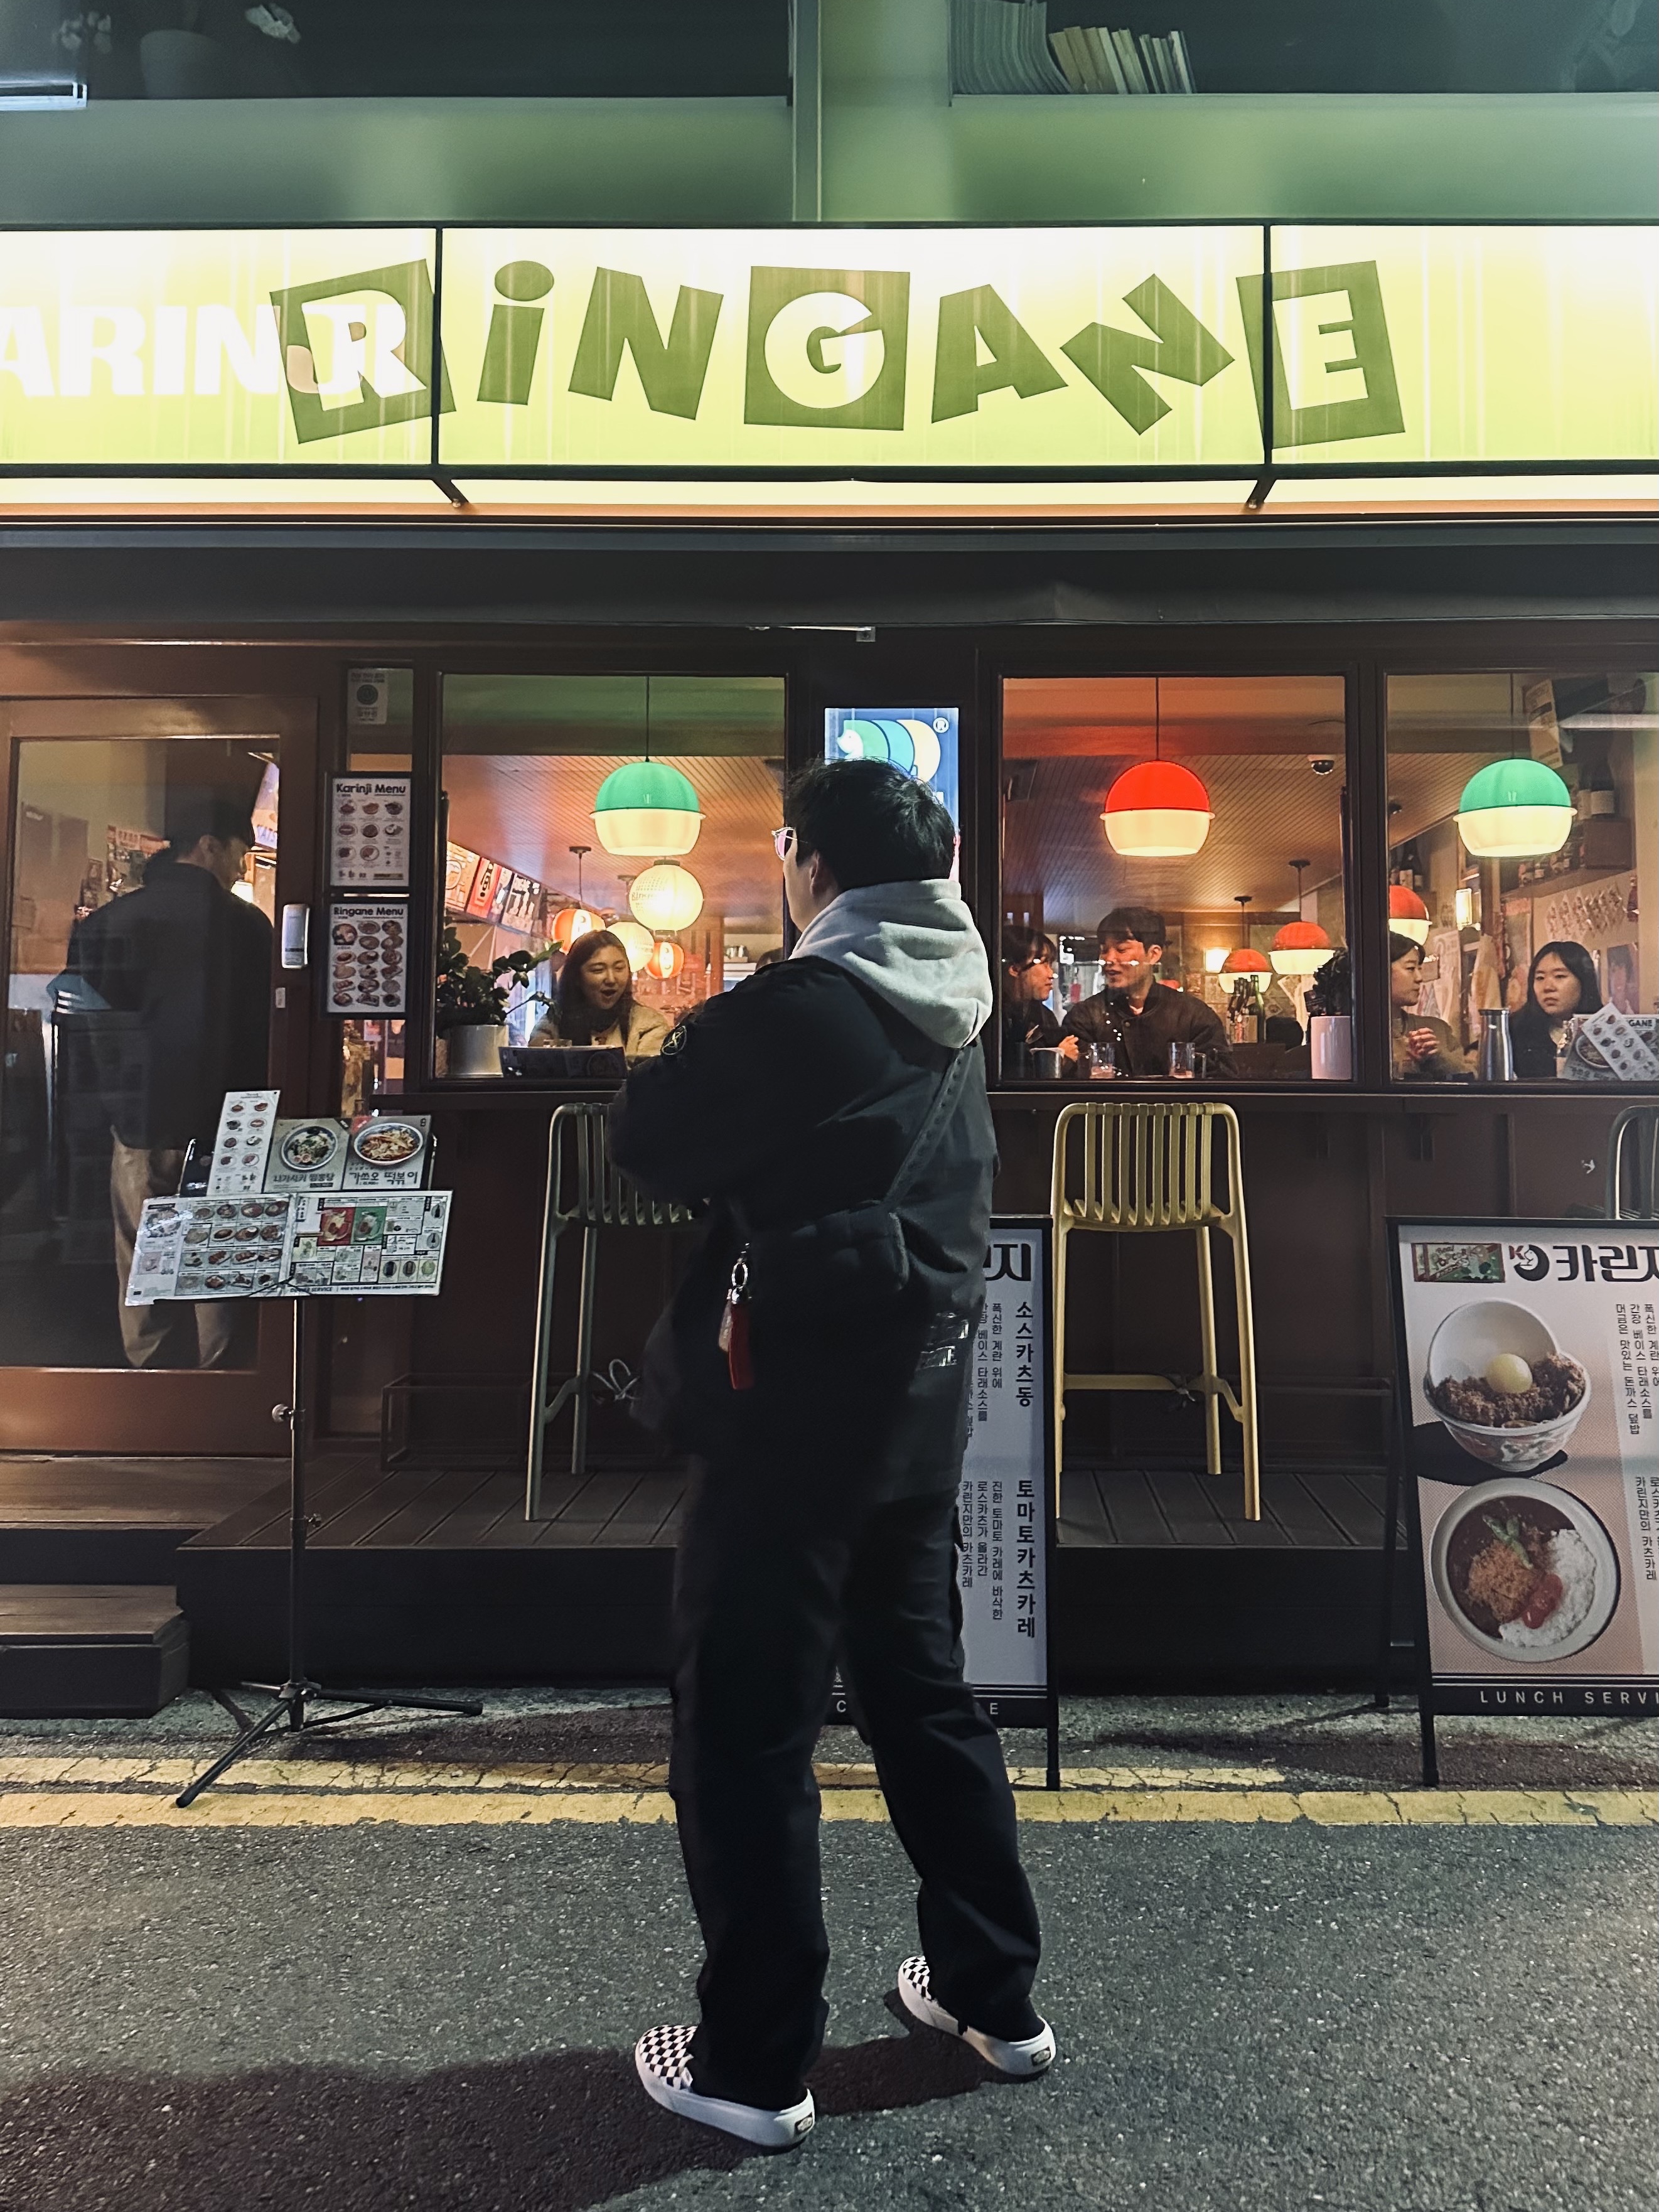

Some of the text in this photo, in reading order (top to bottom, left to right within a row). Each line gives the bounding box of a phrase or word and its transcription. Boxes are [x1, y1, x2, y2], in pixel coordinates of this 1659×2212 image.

[336, 783, 406, 795] Karinji Menu
[333, 906, 373, 916] Ringane
[384, 1172, 418, 1185] 떡볶이
[1629, 1304, 1641, 1324] 간장
[1644, 1304, 1656, 1335] 폭신한
[977, 1329, 988, 1361] 베이스
[992, 1303, 1002, 1389] 폭신한 계란 위에
[1015, 1301, 1034, 1407] 소스카츠동
[1620, 1340, 1633, 1372] 맛있는
[1633, 1329, 1646, 1361] 베이스
[1624, 1377, 1638, 1408] 돈까스
[1628, 1413, 1640, 1435] 덮밥
[1635, 1476, 1651, 1532] 카린지만의
[962, 1481, 974, 1588] 카린지만의 카츠카레
[977, 1481, 988, 1576] 로스카츠가 올라간
[992, 1481, 1002, 1620] 진한 토마토 카레에 바삭한
[1016, 1480, 1036, 1638] 토마토카츠카레
[1642, 1536, 1657, 1581] 카츠카레
[1479, 1690, 1659, 1704] LUNCH SERVI
